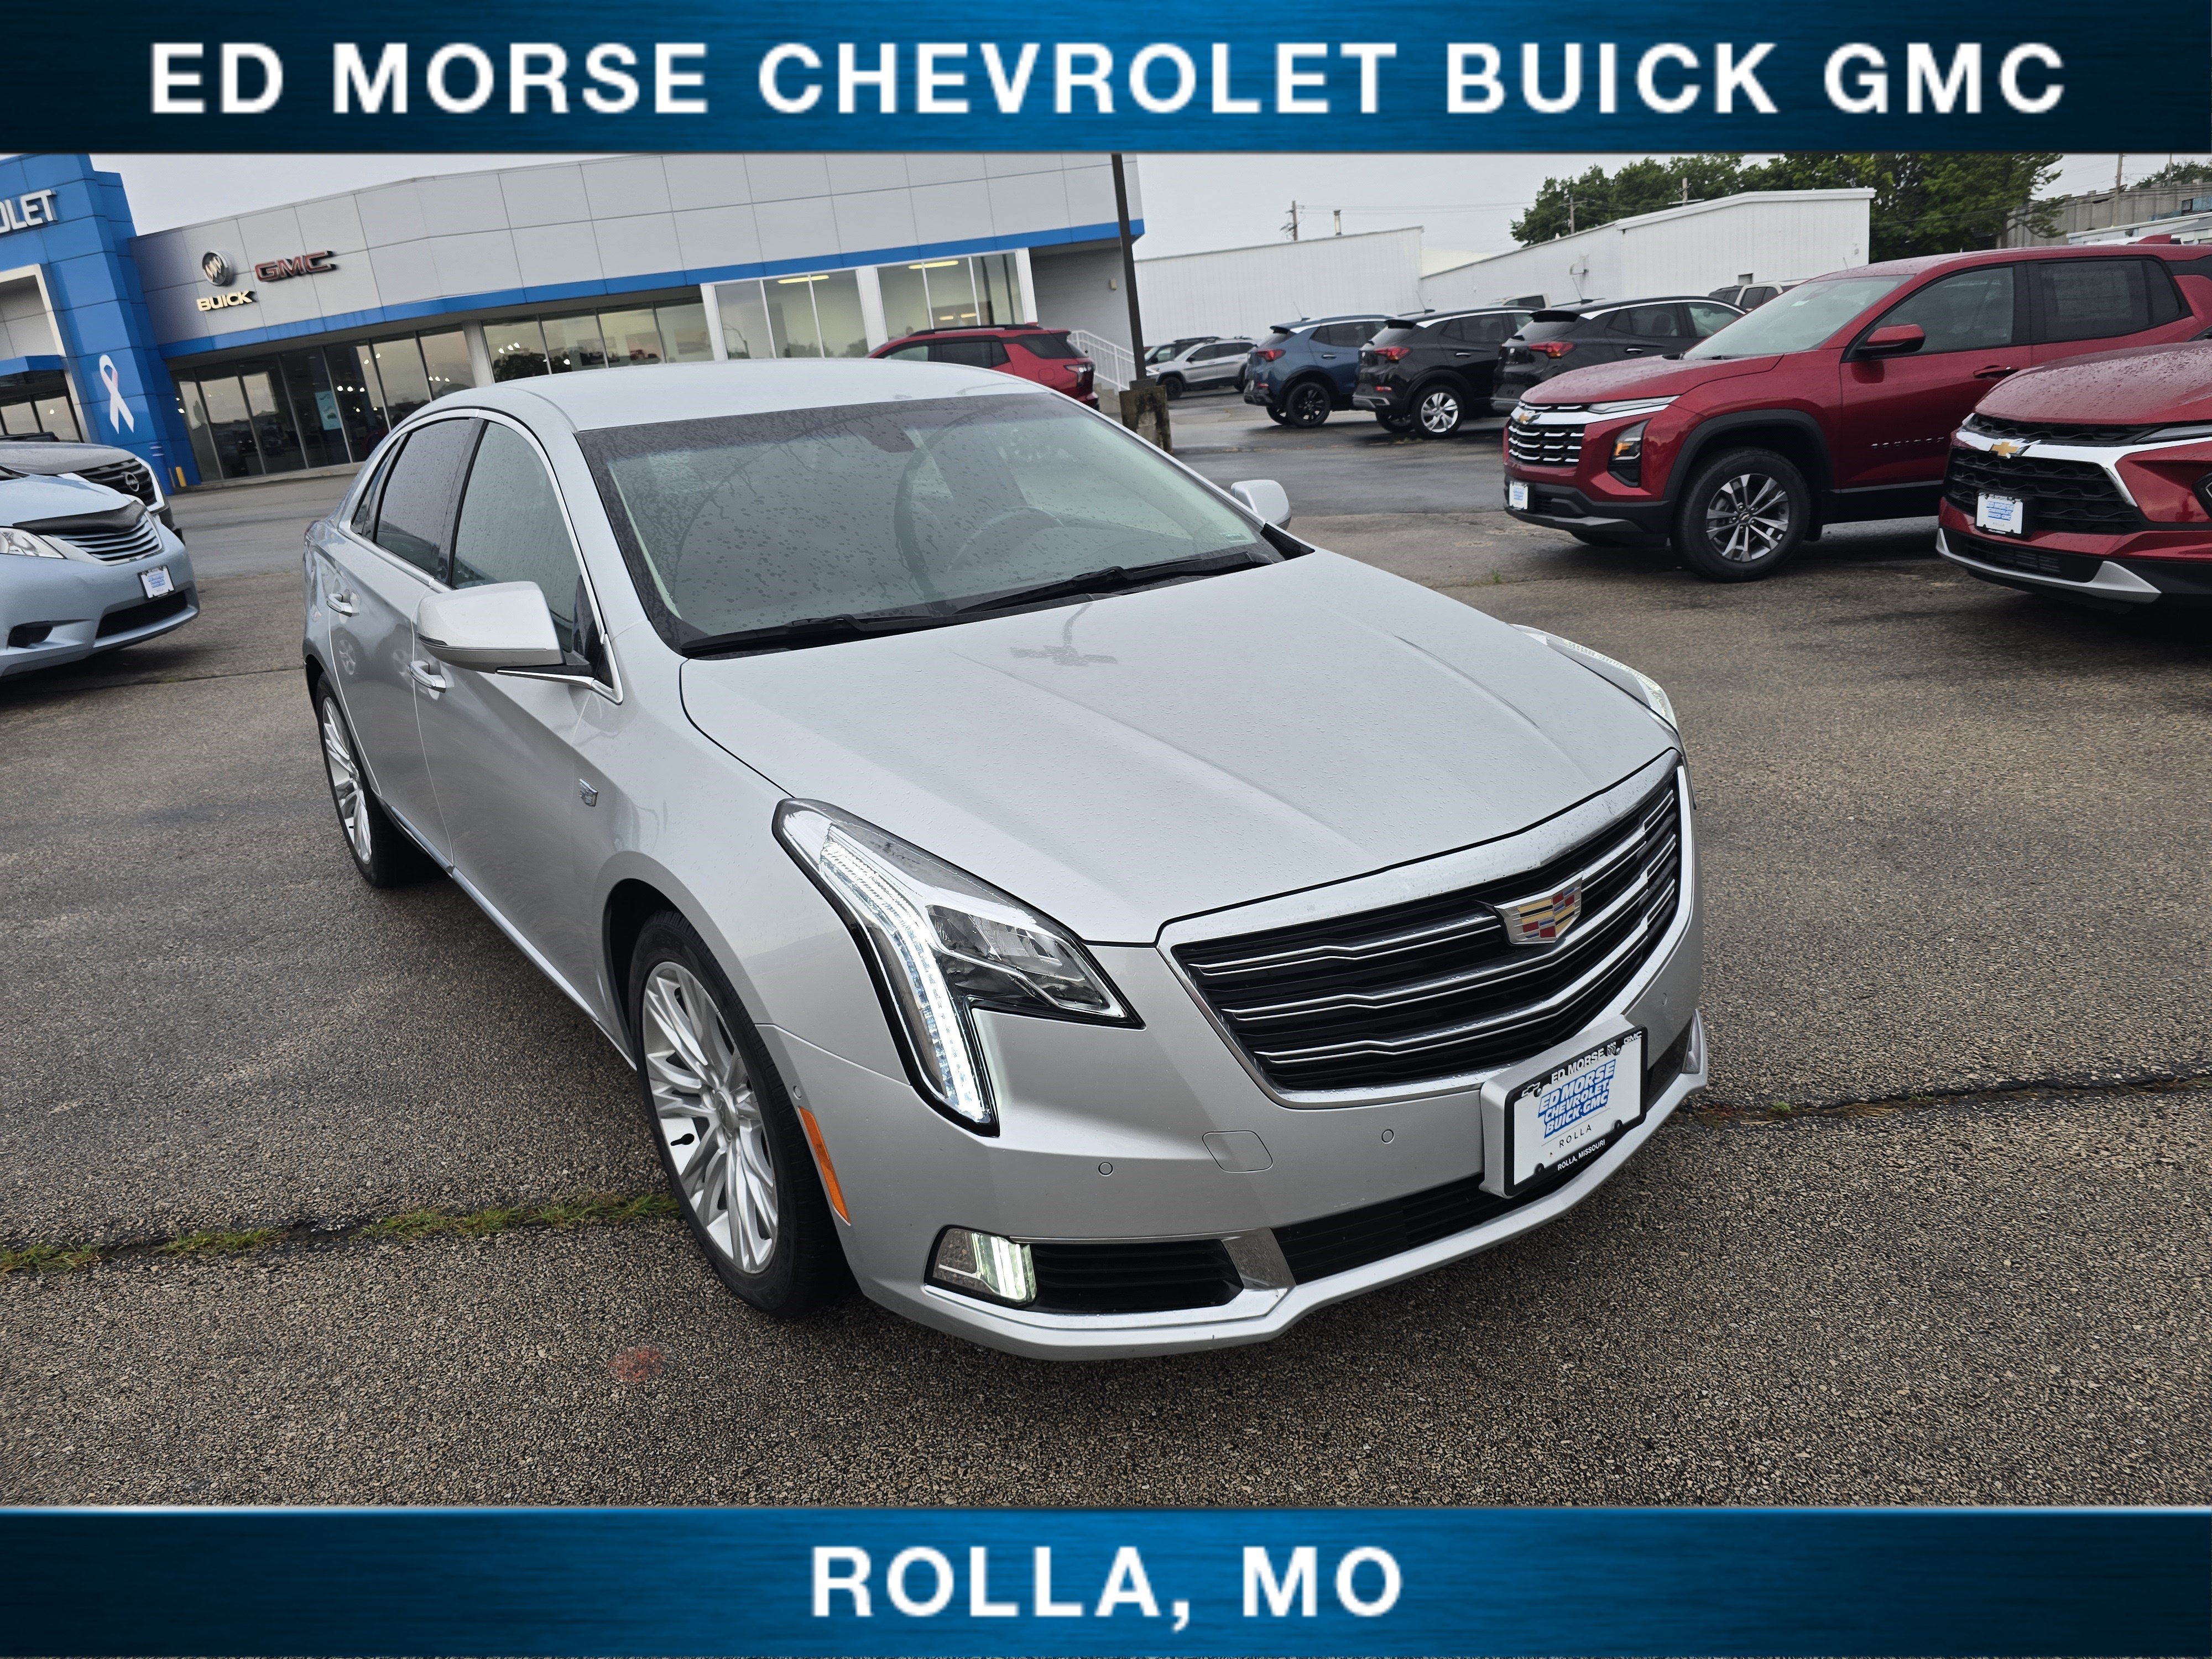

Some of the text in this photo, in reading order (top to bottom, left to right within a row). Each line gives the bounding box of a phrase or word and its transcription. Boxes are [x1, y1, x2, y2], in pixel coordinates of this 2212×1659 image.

[255, 251, 332, 282] GMC
[196, 290, 253, 311] BUICK
[1624, 1031, 1642, 1045] GMC
[1551, 1048, 1604, 1084] ED MORSE
[1538, 1060, 1615, 1113] ED MORSE
[1559, 1124, 1592, 1148] ROLLA
[1557, 1139, 1605, 1171] ROLLA, MISSOURI
